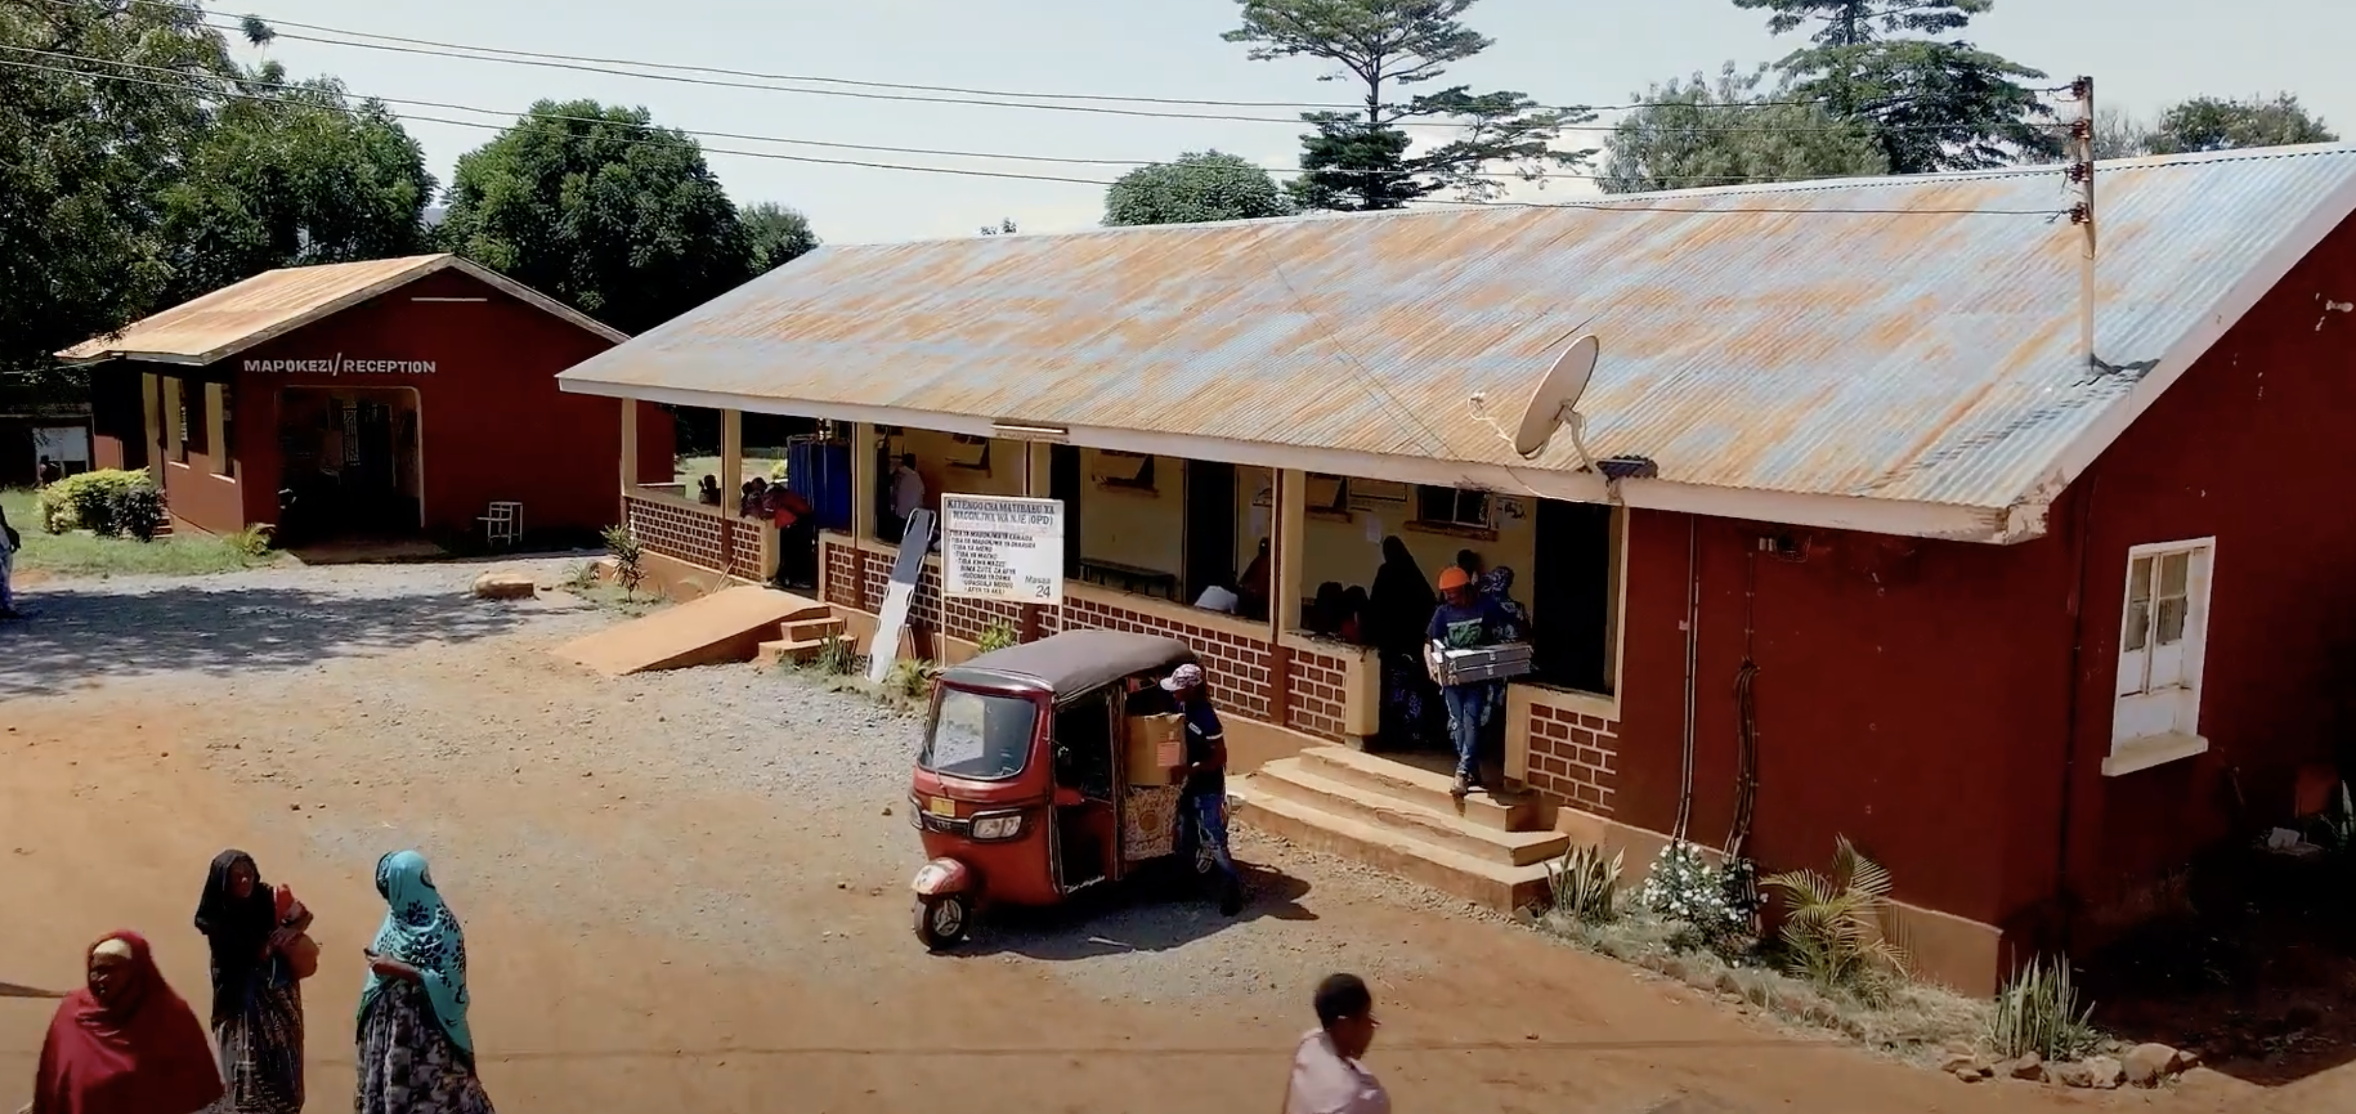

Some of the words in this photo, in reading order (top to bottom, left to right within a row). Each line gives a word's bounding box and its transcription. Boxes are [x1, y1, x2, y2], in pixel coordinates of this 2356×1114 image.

[243, 352, 436, 377] MAPOKEZI/RECEPTION
[947, 499, 982, 511] KITENGO
[1028, 514, 1052, 526] (OPD)
[1035, 584, 1050, 598] 24
